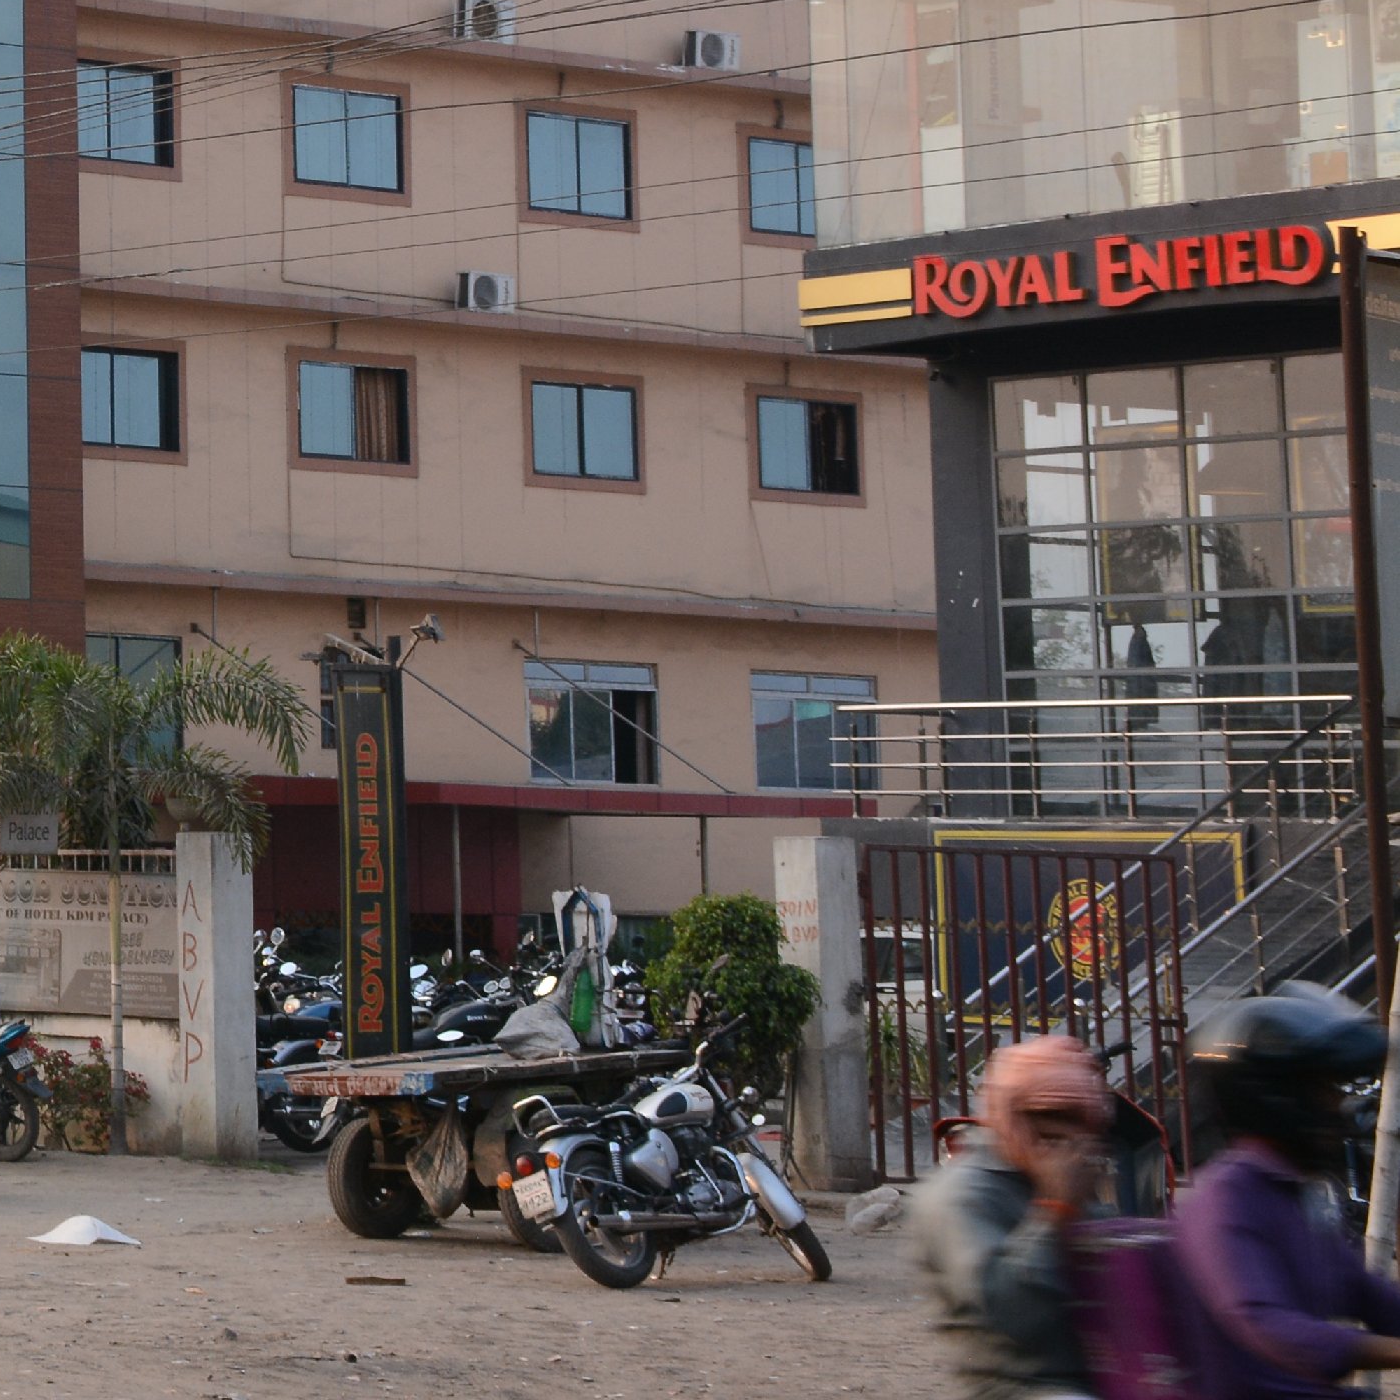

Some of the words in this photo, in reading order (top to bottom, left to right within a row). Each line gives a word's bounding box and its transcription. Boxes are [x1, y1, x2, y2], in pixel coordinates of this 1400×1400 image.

[912, 249, 1086, 319] ROYAL
[1094, 225, 1325, 308] ENFIELD
[355, 731, 385, 894] ENFIELD
[7, 821, 51, 841] Palace
[60, 878, 178, 909] JUNTION
[778, 898, 818, 918] JOIN
[5, 907, 21, 920] OF
[24, 908, 63, 921] HOTEL
[66, 909, 94, 922] KDM
[97, 910, 149, 927] PACE)
[357, 901, 385, 1034] ROYAL
